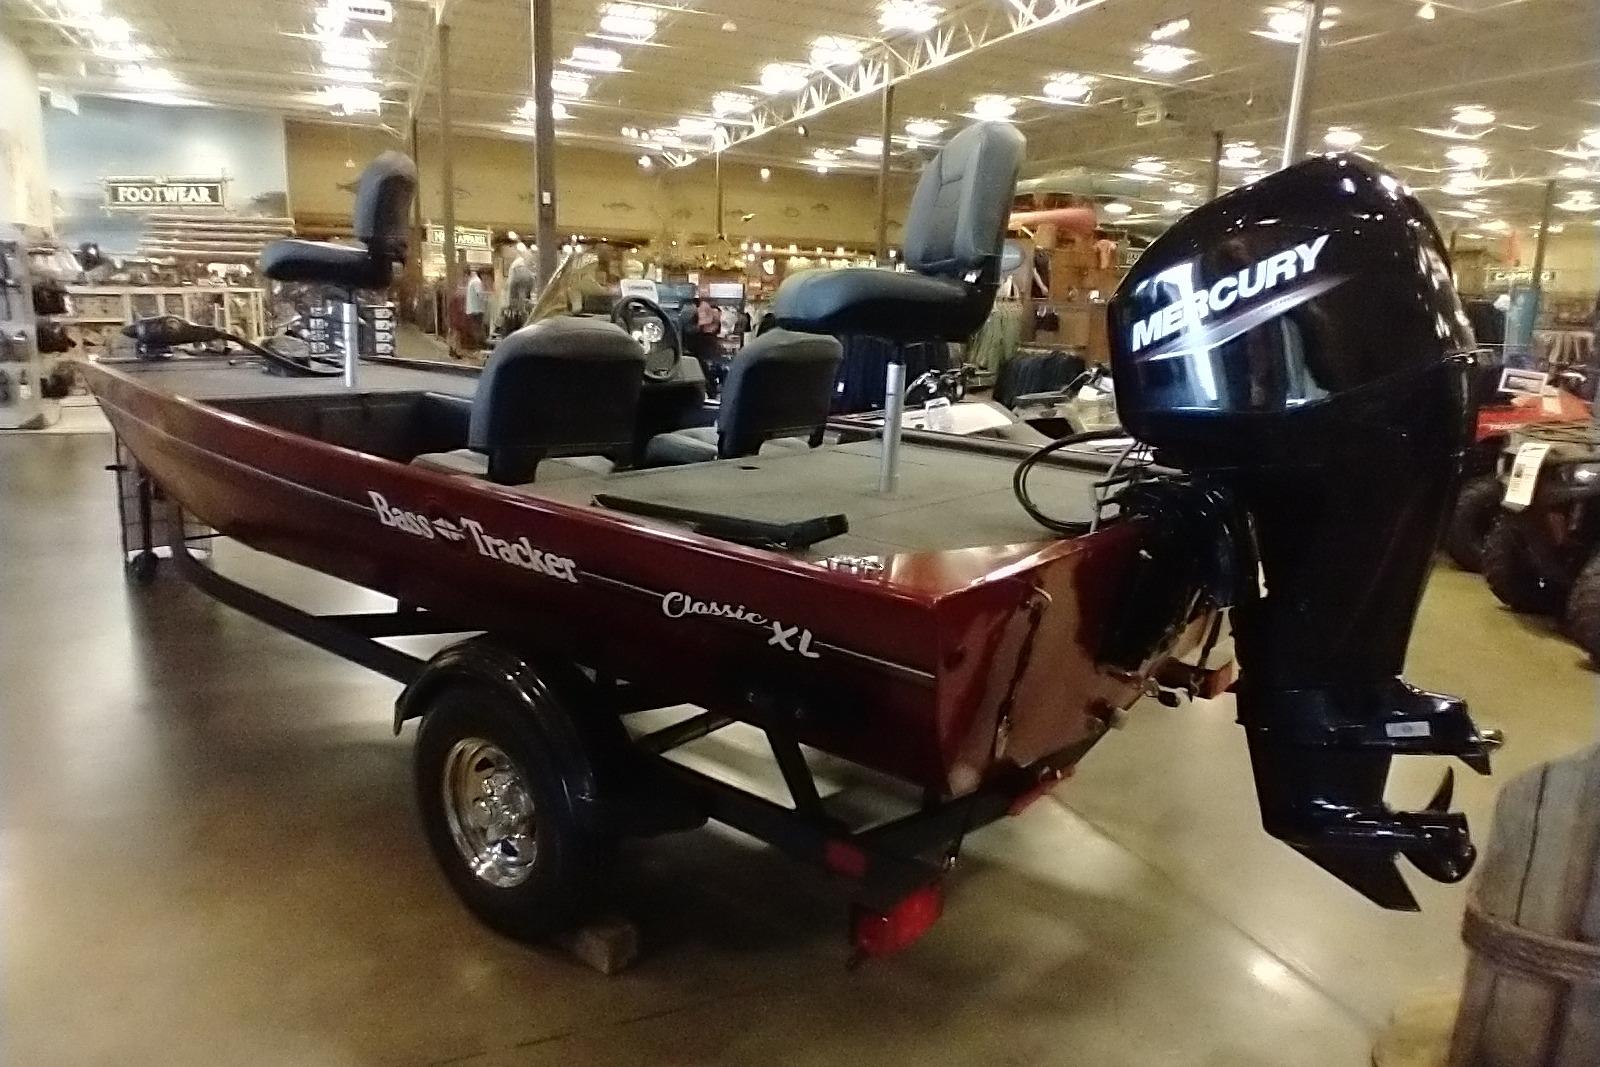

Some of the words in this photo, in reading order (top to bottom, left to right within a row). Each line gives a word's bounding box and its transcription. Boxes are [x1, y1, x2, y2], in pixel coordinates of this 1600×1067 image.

[117, 186, 212, 203] FOOTWEAR
[1132, 234, 1330, 352] MERCURY
[368, 490, 435, 539] Bass
[459, 516, 578, 584] Tracker
[662, 591, 768, 624] Classic
[767, 621, 820, 658] XL
